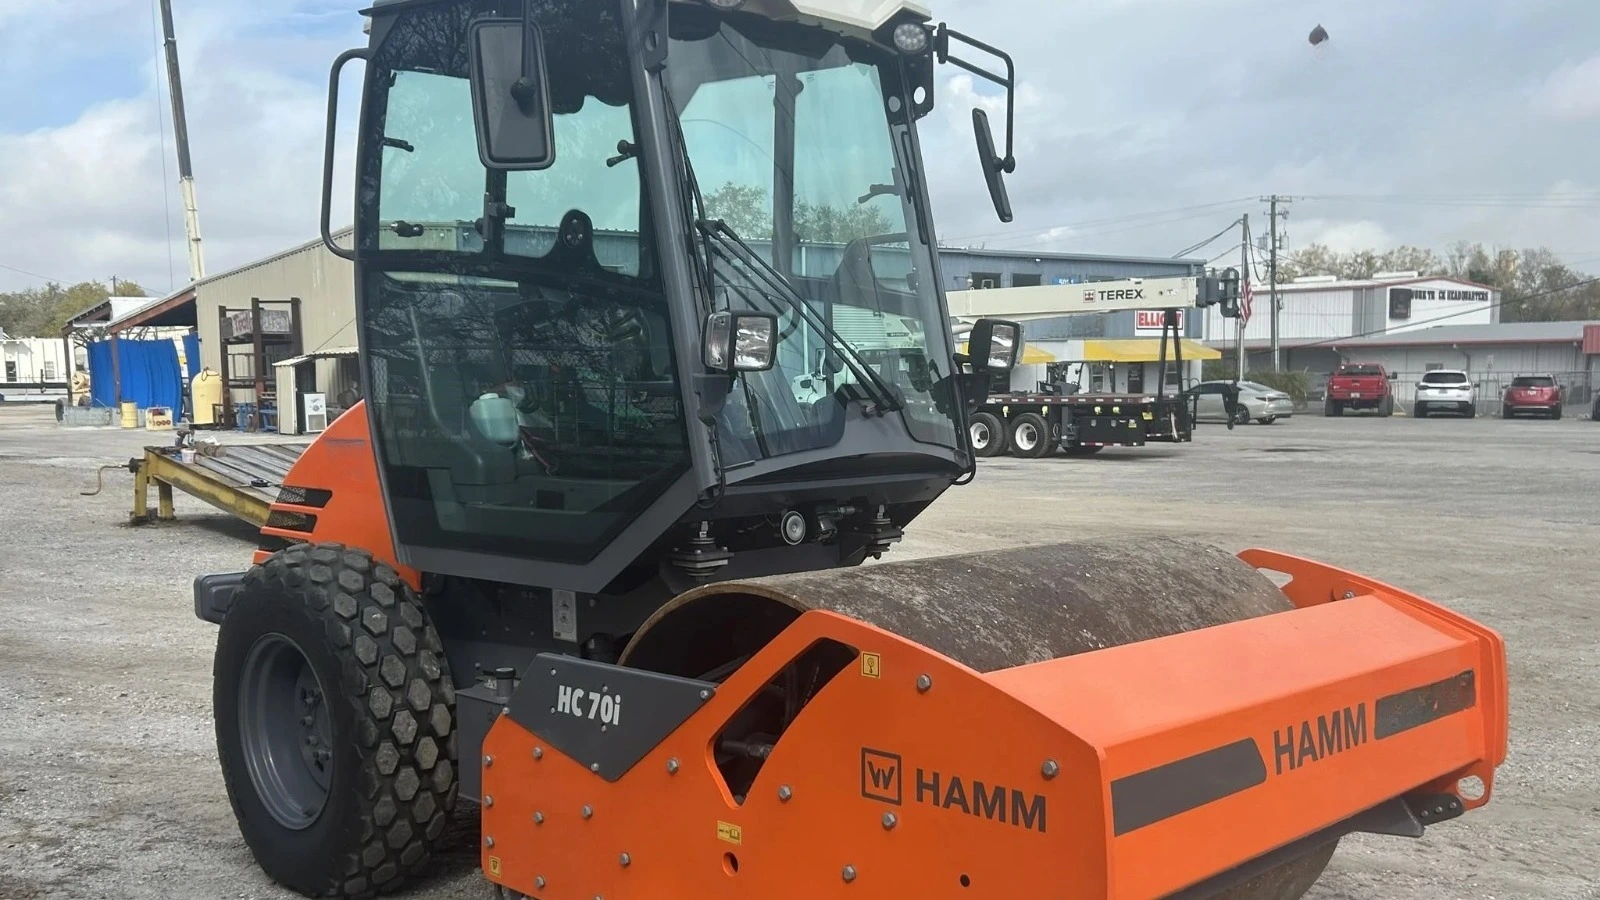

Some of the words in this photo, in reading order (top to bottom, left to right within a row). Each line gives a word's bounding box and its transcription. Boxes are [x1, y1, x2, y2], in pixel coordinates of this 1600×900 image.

[1098, 289, 1143, 300] TEREX
[557, 685, 584, 717] HC
[588, 691, 621, 725] 70i
[1274, 703, 1367, 775] HAMM
[917, 768, 1046, 833] HAMM
